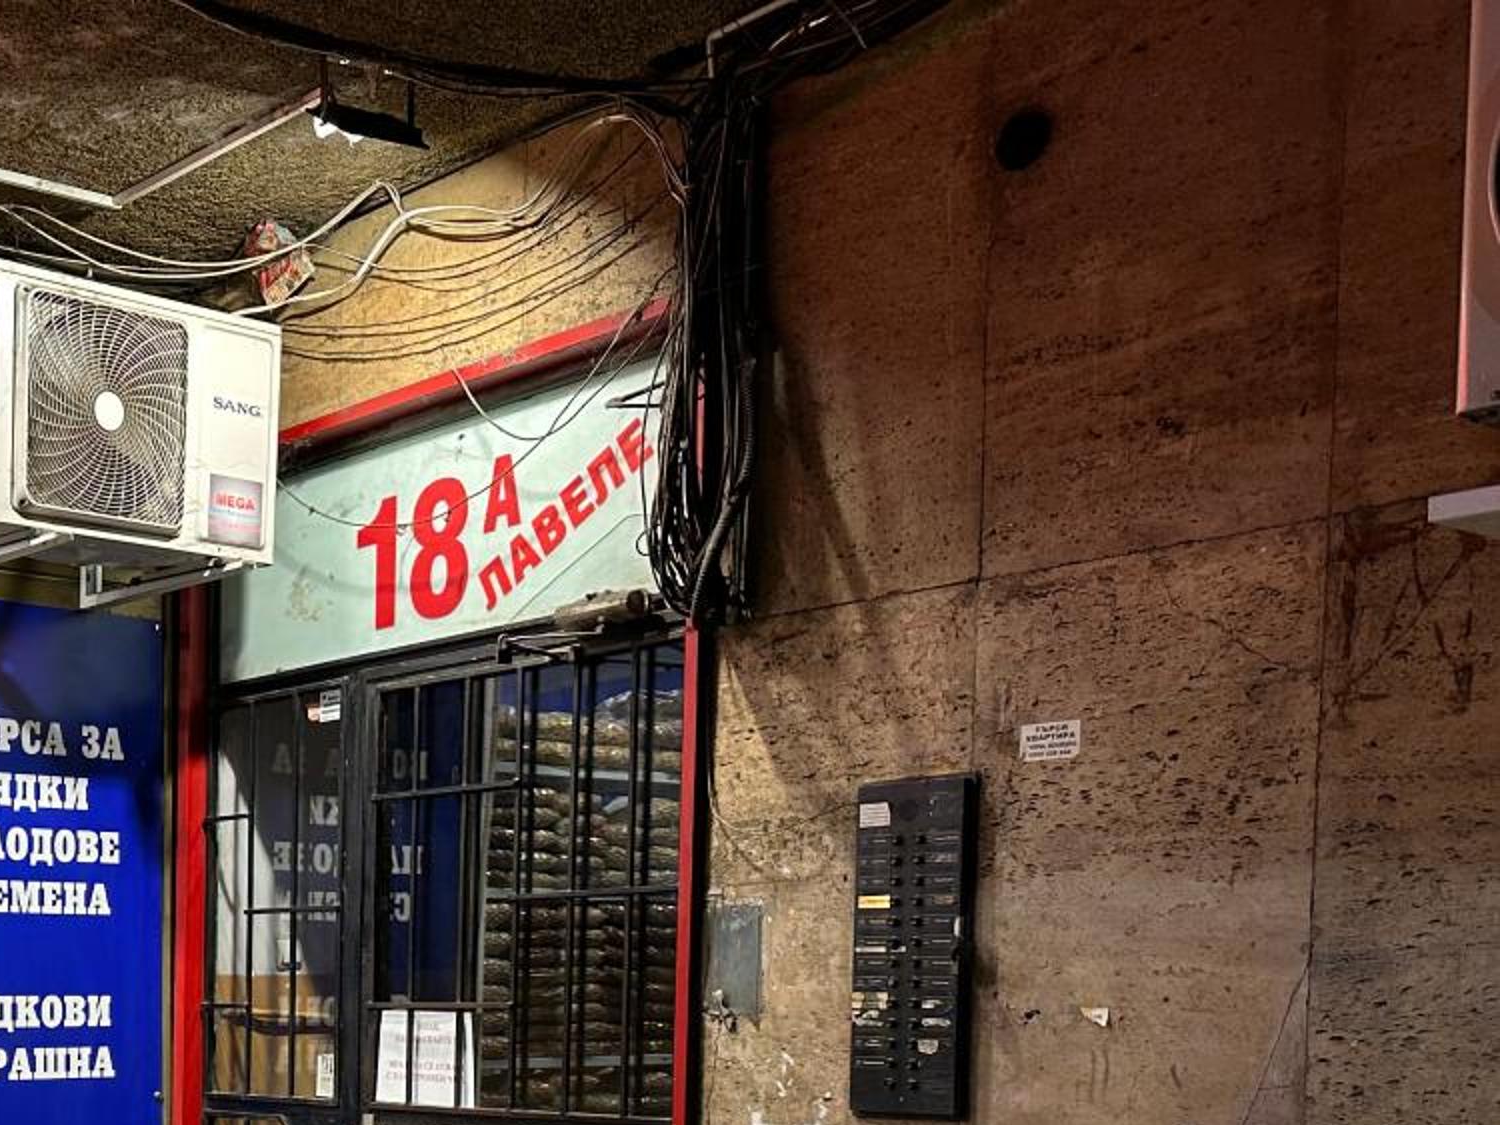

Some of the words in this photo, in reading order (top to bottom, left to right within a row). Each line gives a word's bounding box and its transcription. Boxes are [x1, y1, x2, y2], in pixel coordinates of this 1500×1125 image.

[213, 396, 261, 417] SANG
[214, 493, 255, 511] MEGA
[81, 725, 125, 761] ЗА
